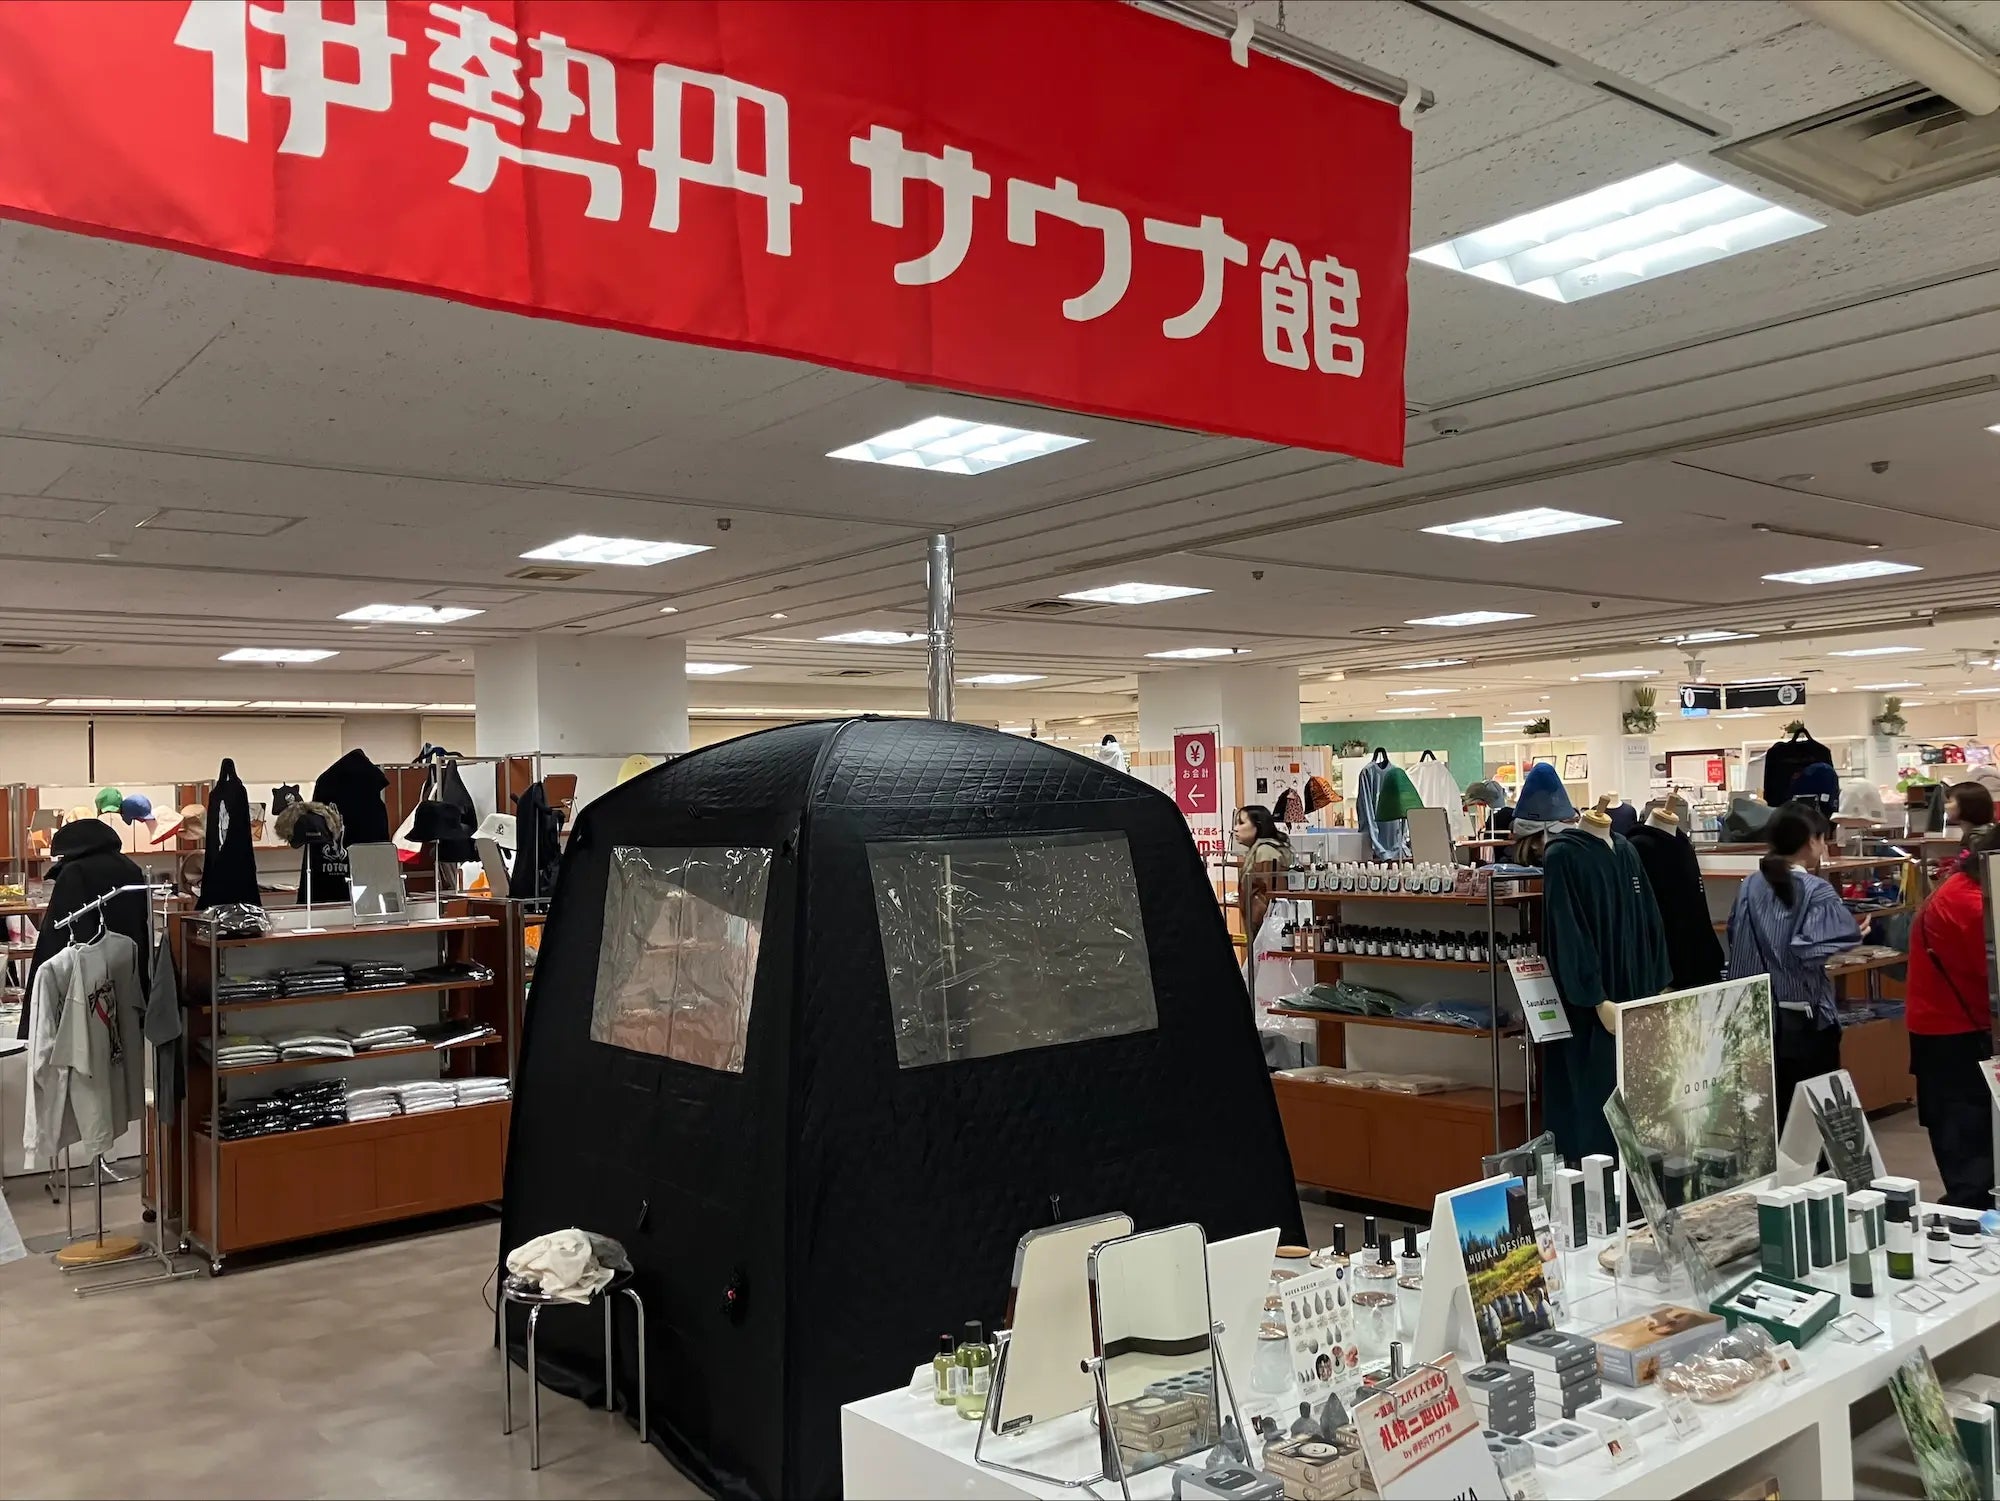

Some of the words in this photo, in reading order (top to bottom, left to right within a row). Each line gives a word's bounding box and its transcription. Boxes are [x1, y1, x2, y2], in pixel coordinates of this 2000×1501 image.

[174, 0, 803, 258] 伊勢丹
[850, 124, 1365, 378] サウナ館
[1182, 768, 1209, 779] お会計
[1684, 1077, 1717, 1095] aono
[1468, 1247, 1499, 1265] HUKKA
[1500, 1235, 1532, 1254] DESIGN
